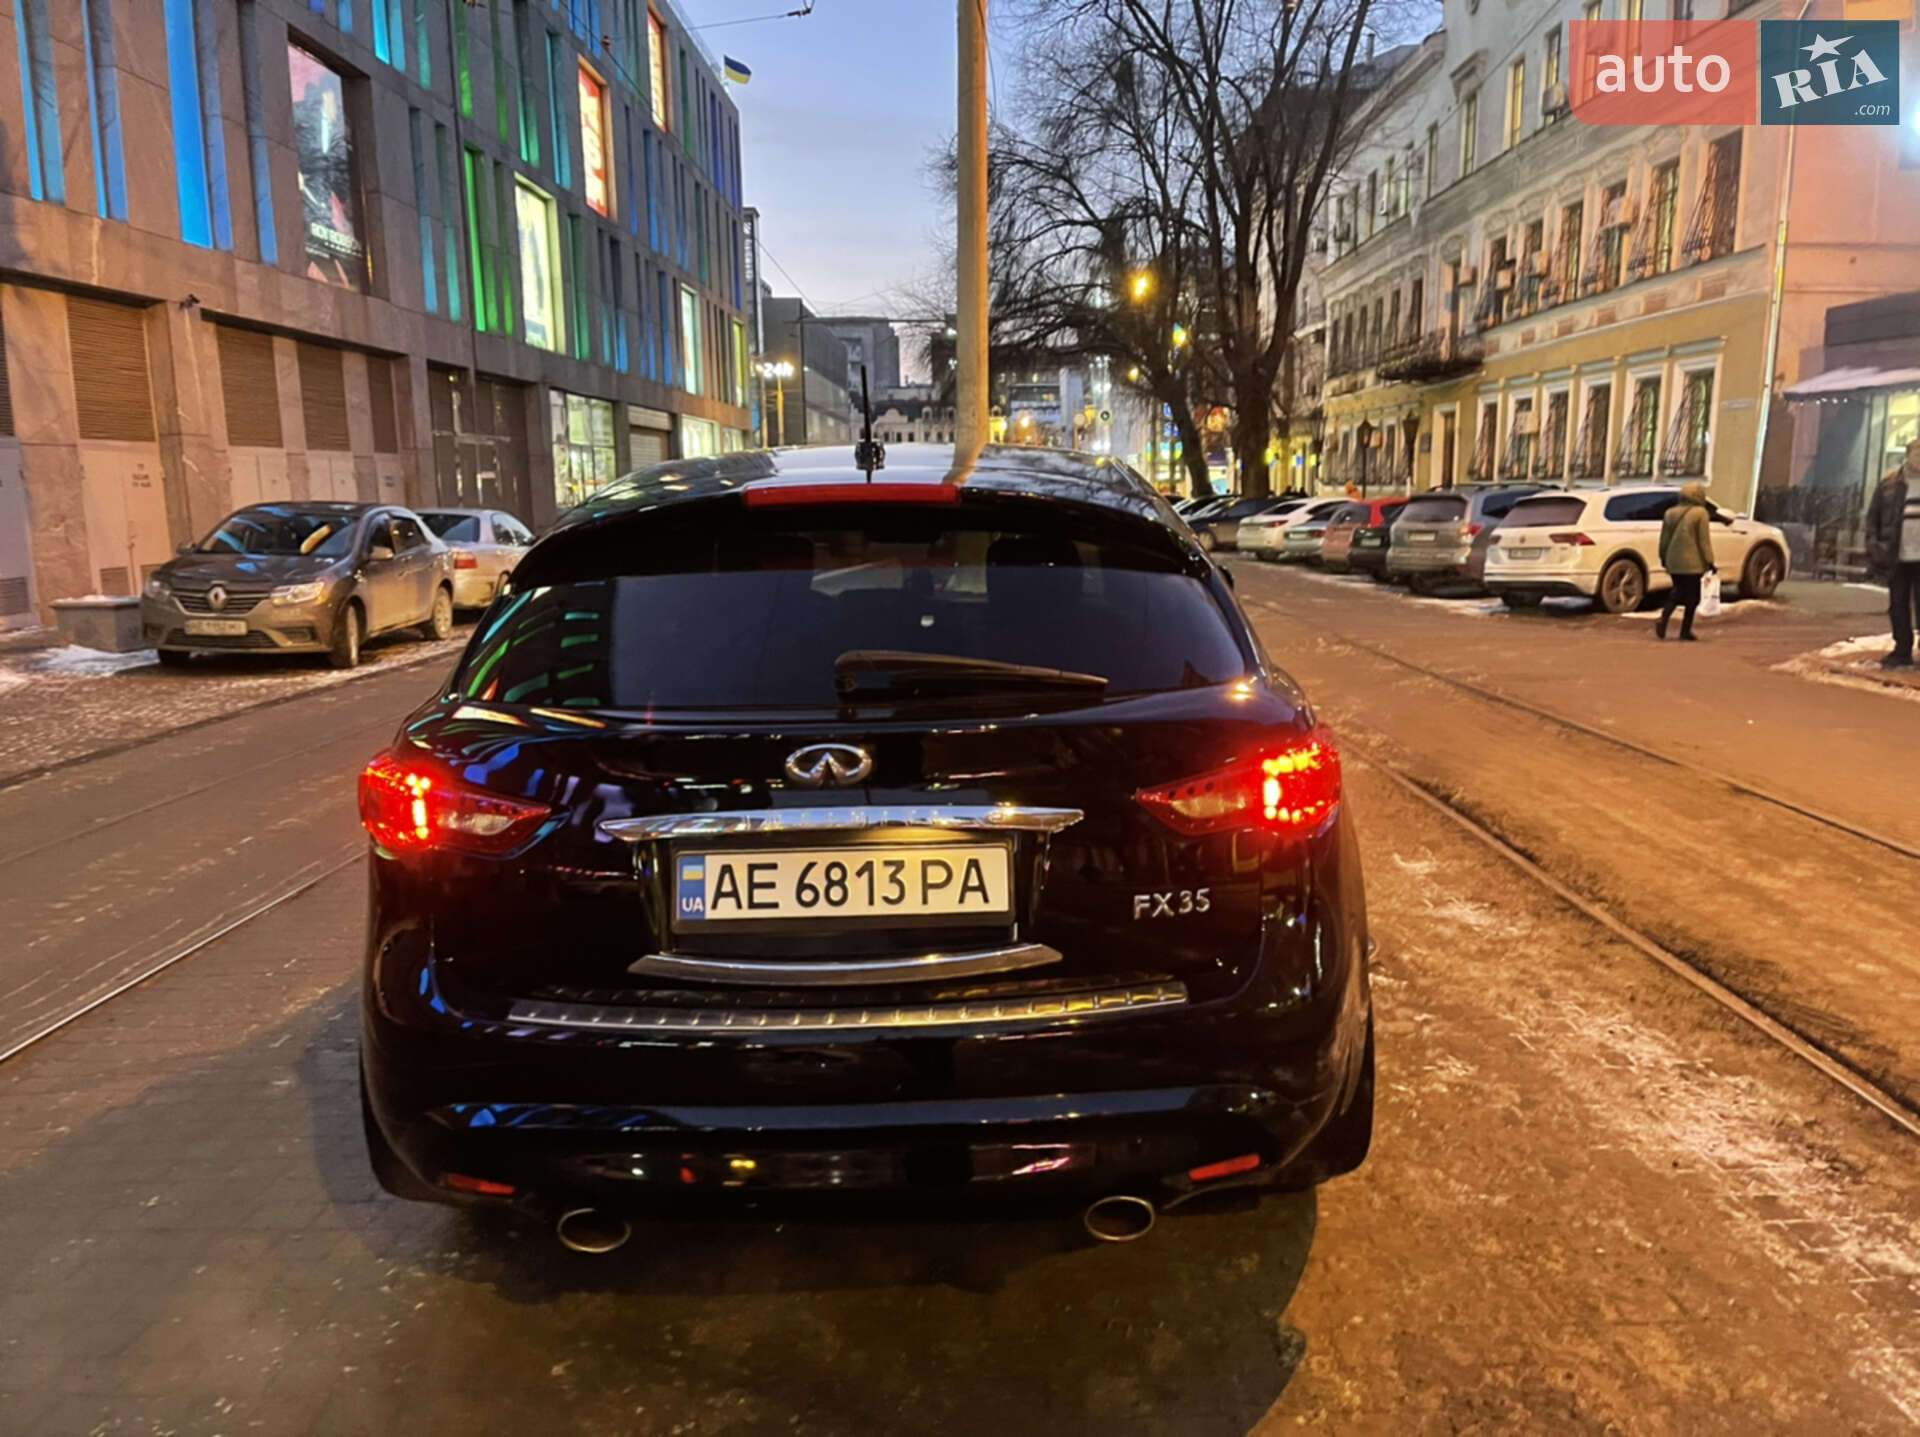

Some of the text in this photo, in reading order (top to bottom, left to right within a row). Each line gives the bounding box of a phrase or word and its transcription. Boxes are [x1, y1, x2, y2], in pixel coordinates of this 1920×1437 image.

[710, 857, 990, 911] AE 6813 PA
[681, 896, 705, 913] UA
[1133, 887, 1211, 920] FX35
